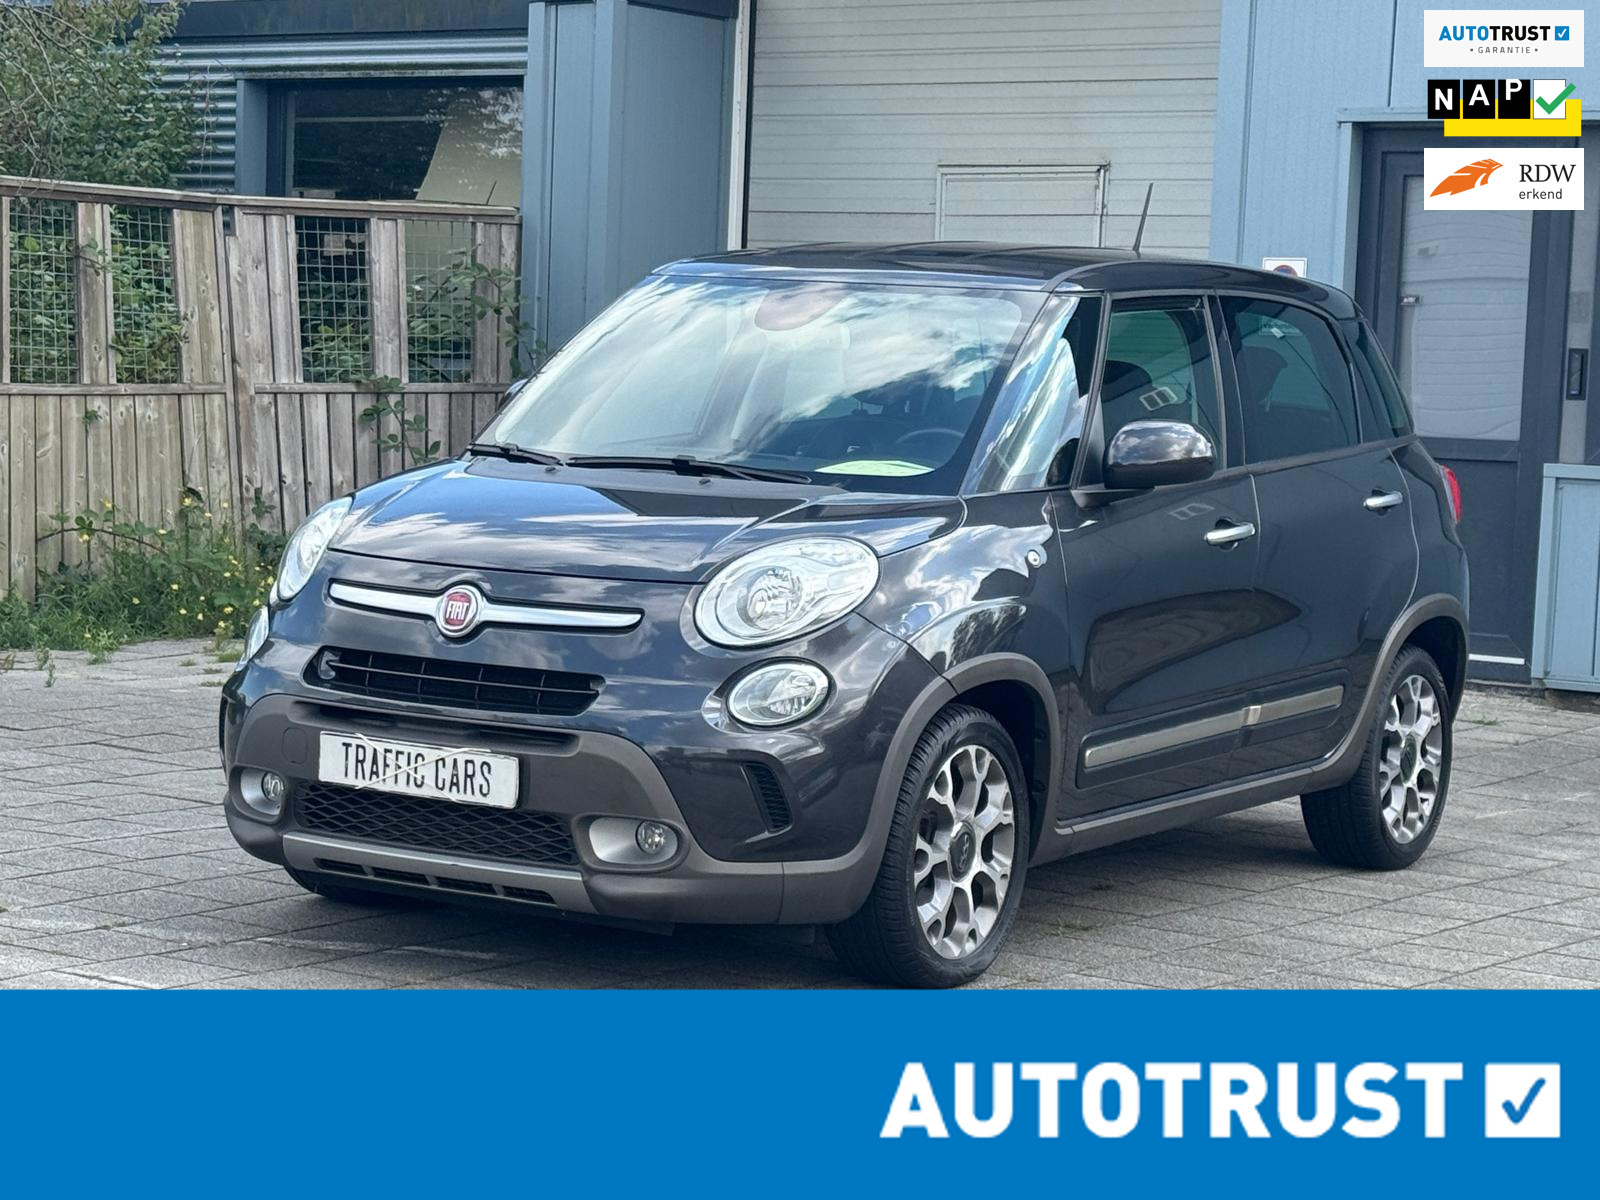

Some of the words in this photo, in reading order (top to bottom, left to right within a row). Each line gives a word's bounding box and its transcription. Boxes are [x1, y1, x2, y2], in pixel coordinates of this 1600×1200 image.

[446, 600, 470, 620] FIAT
[342, 742, 425, 788] TRAFFIC
[435, 757, 492, 797] CARS
